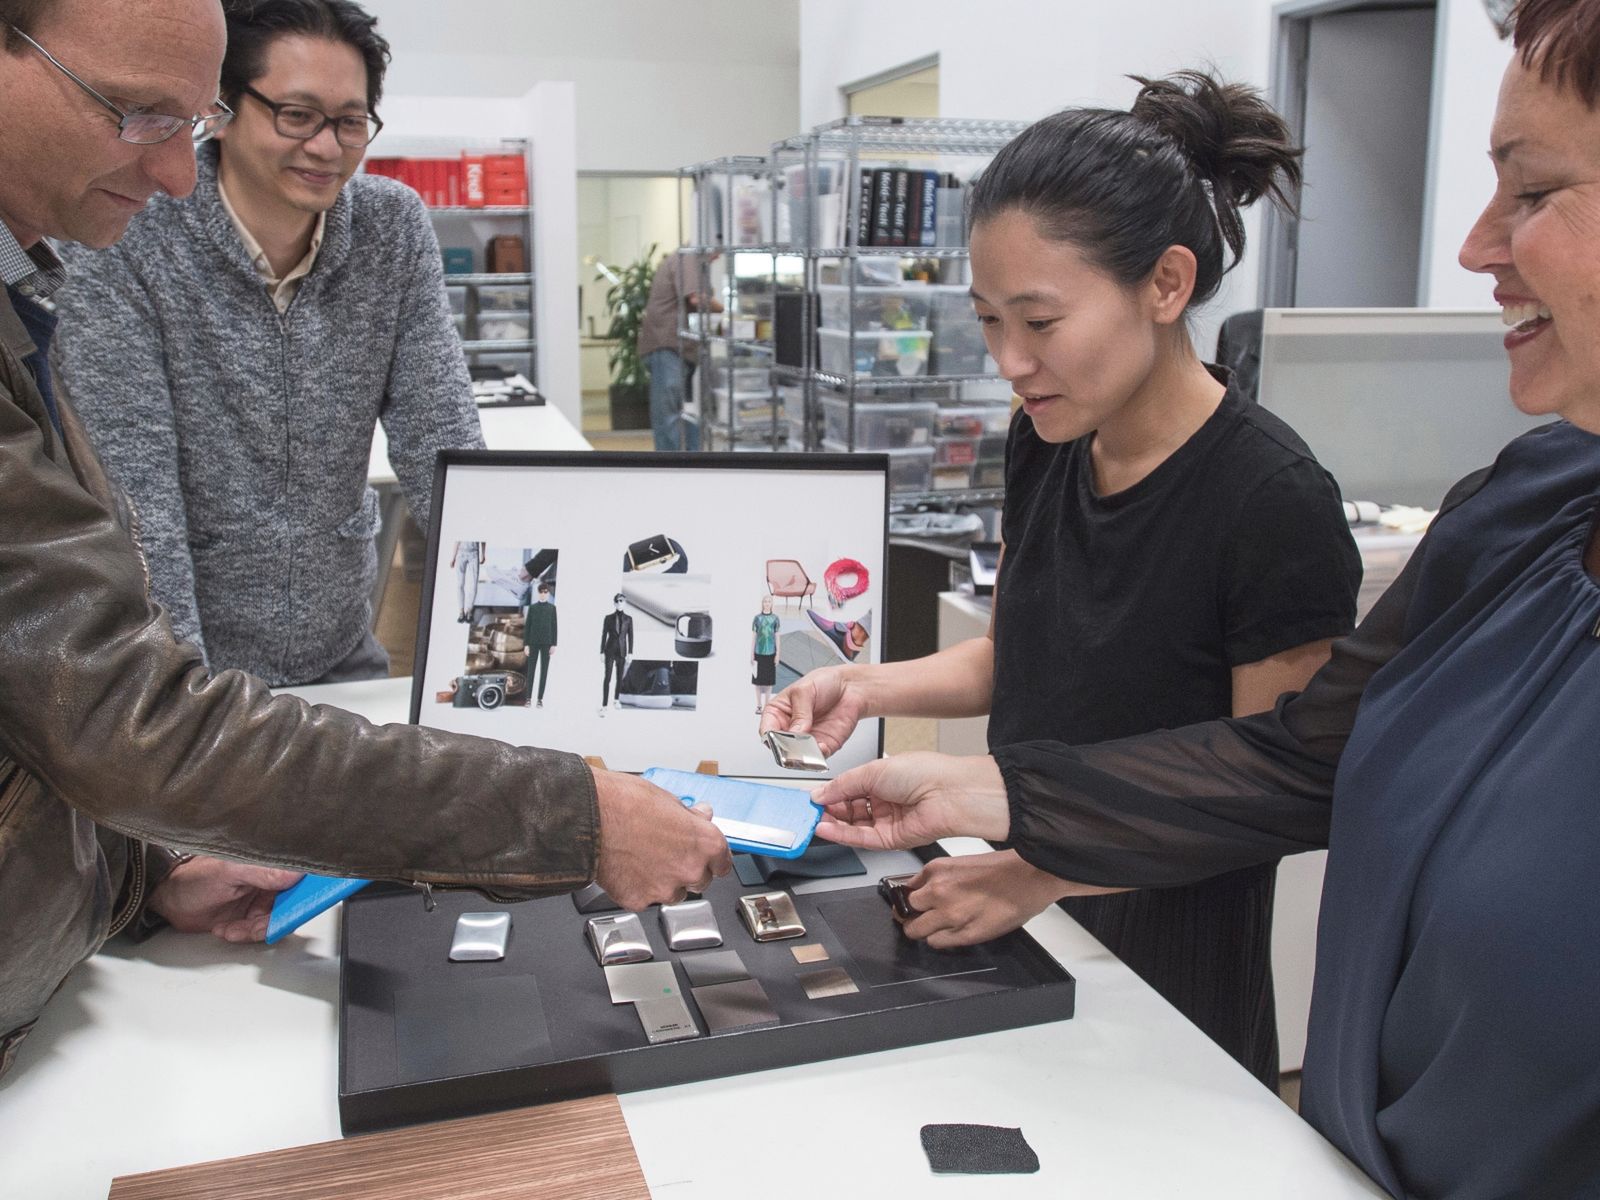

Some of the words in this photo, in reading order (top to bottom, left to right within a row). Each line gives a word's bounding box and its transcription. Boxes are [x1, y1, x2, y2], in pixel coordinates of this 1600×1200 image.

[468, 163, 483, 199] Knoll
[879, 172, 891, 226] Mold-Tech
[895, 172, 907, 226] Mold-Tech
